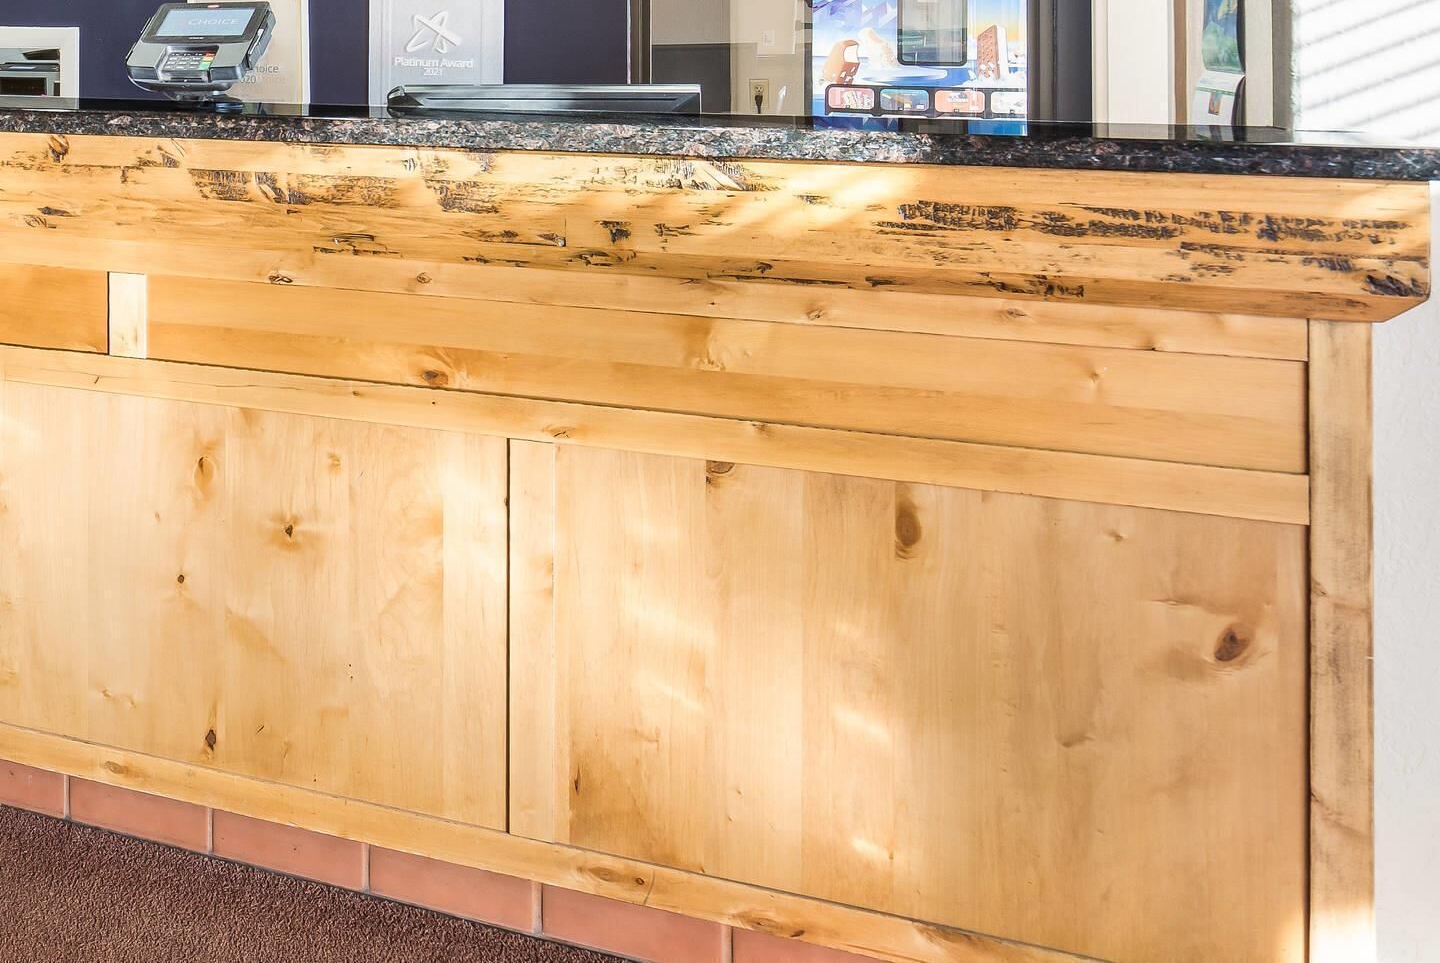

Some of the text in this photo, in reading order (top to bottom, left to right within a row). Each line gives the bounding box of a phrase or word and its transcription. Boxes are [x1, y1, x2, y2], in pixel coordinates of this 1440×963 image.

[187, 18, 240, 26] CHOICE
[393, 56, 474, 69] Platinum Award
[423, 67, 443, 77] 2021
